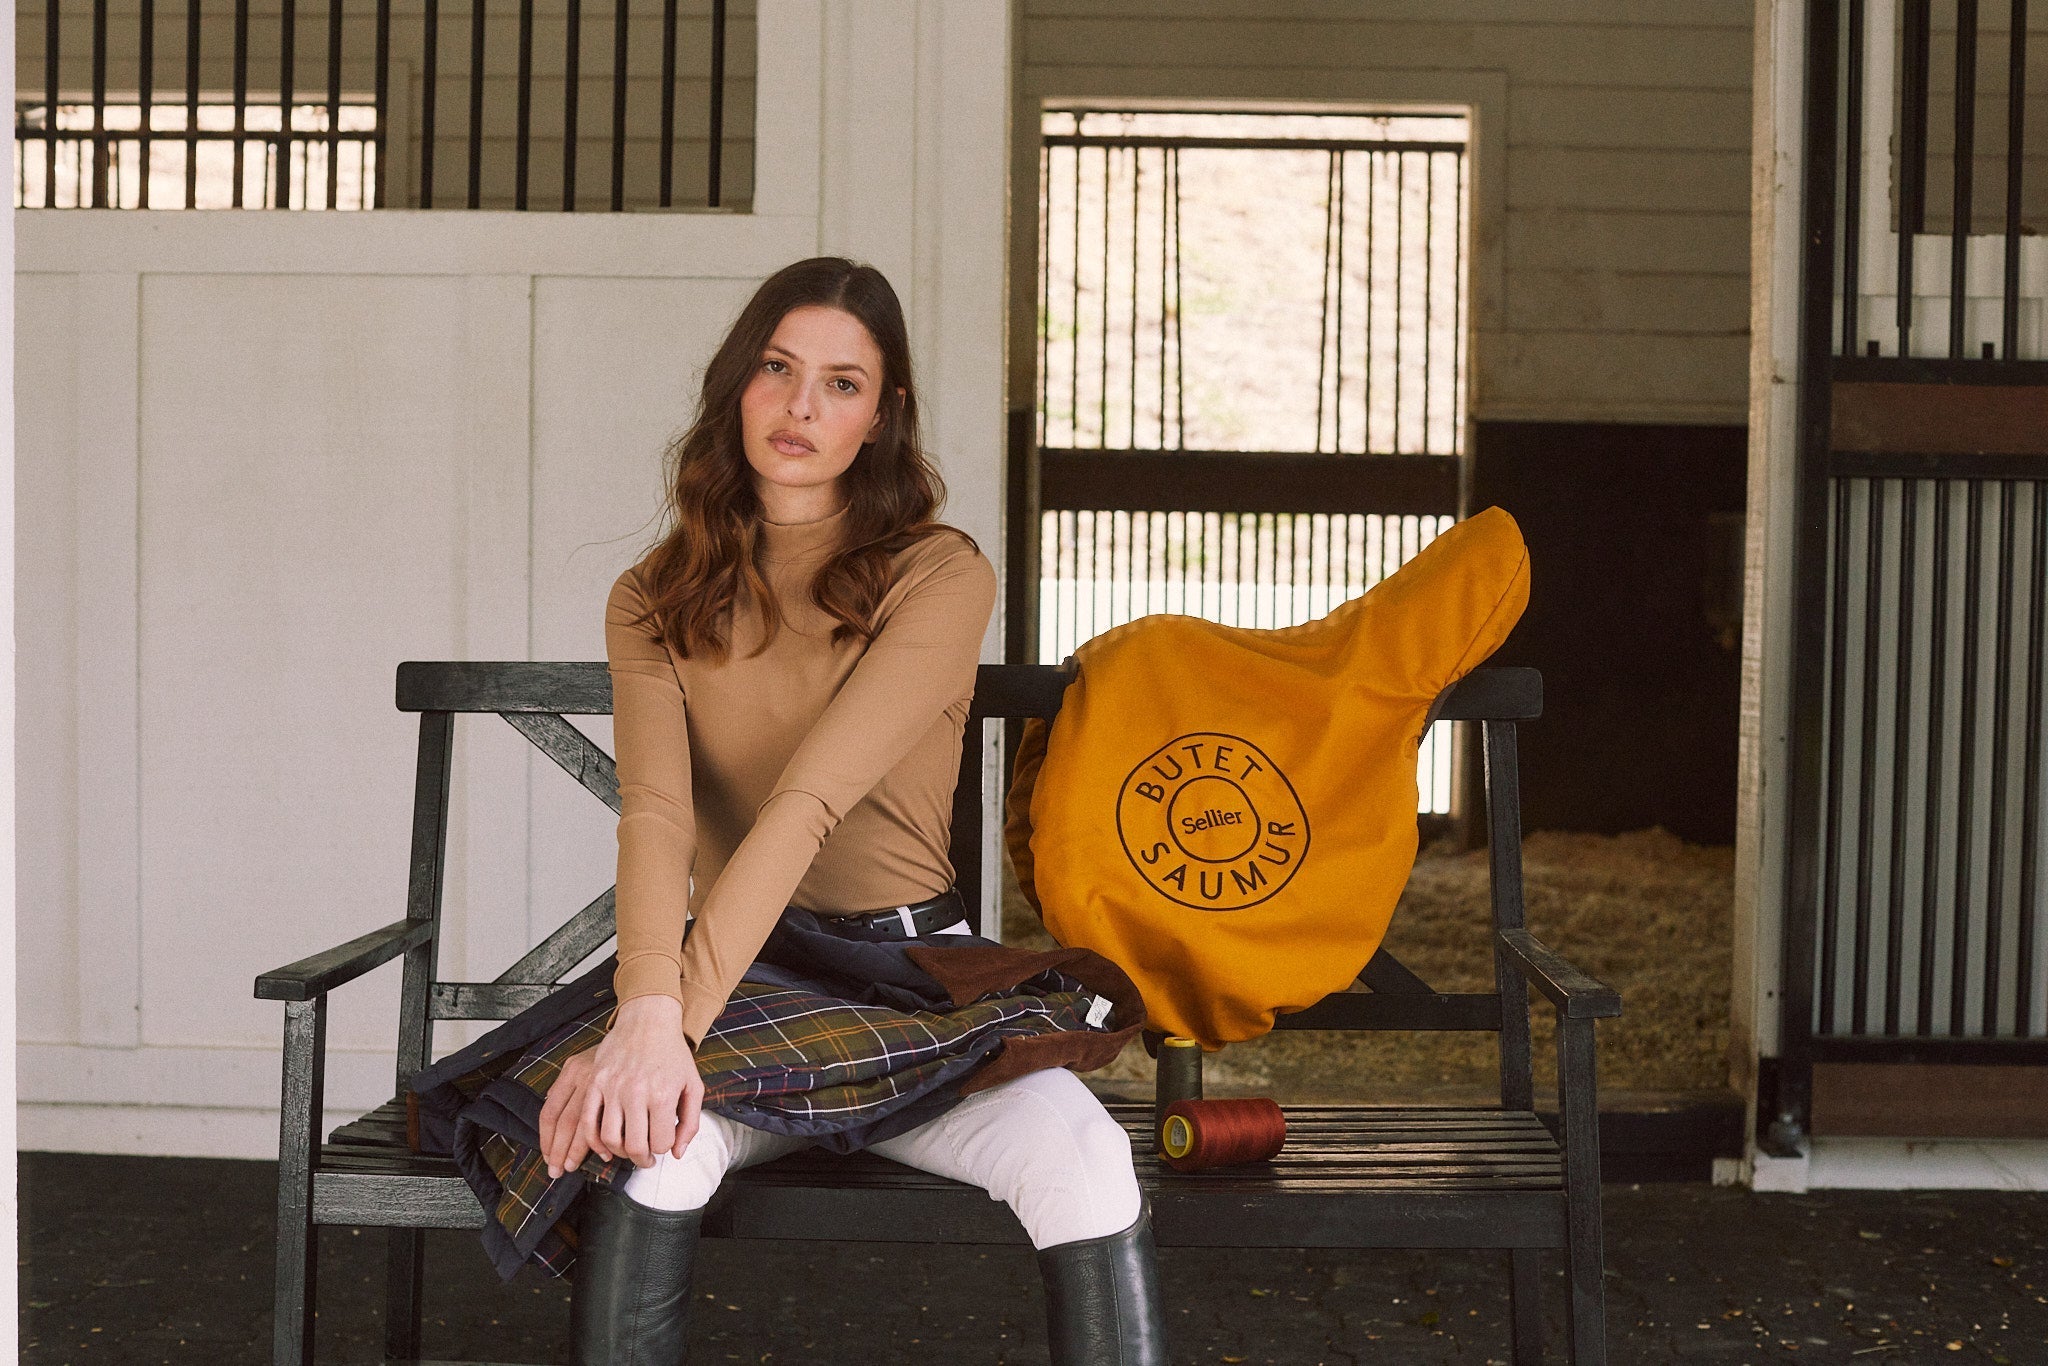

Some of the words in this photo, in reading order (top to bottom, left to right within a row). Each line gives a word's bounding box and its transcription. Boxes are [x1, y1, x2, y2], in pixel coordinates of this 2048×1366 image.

[1134, 743, 1263, 804] BUTET
[1181, 808, 1243, 835] Sellier
[1140, 821, 1296, 900] SAUMUR
